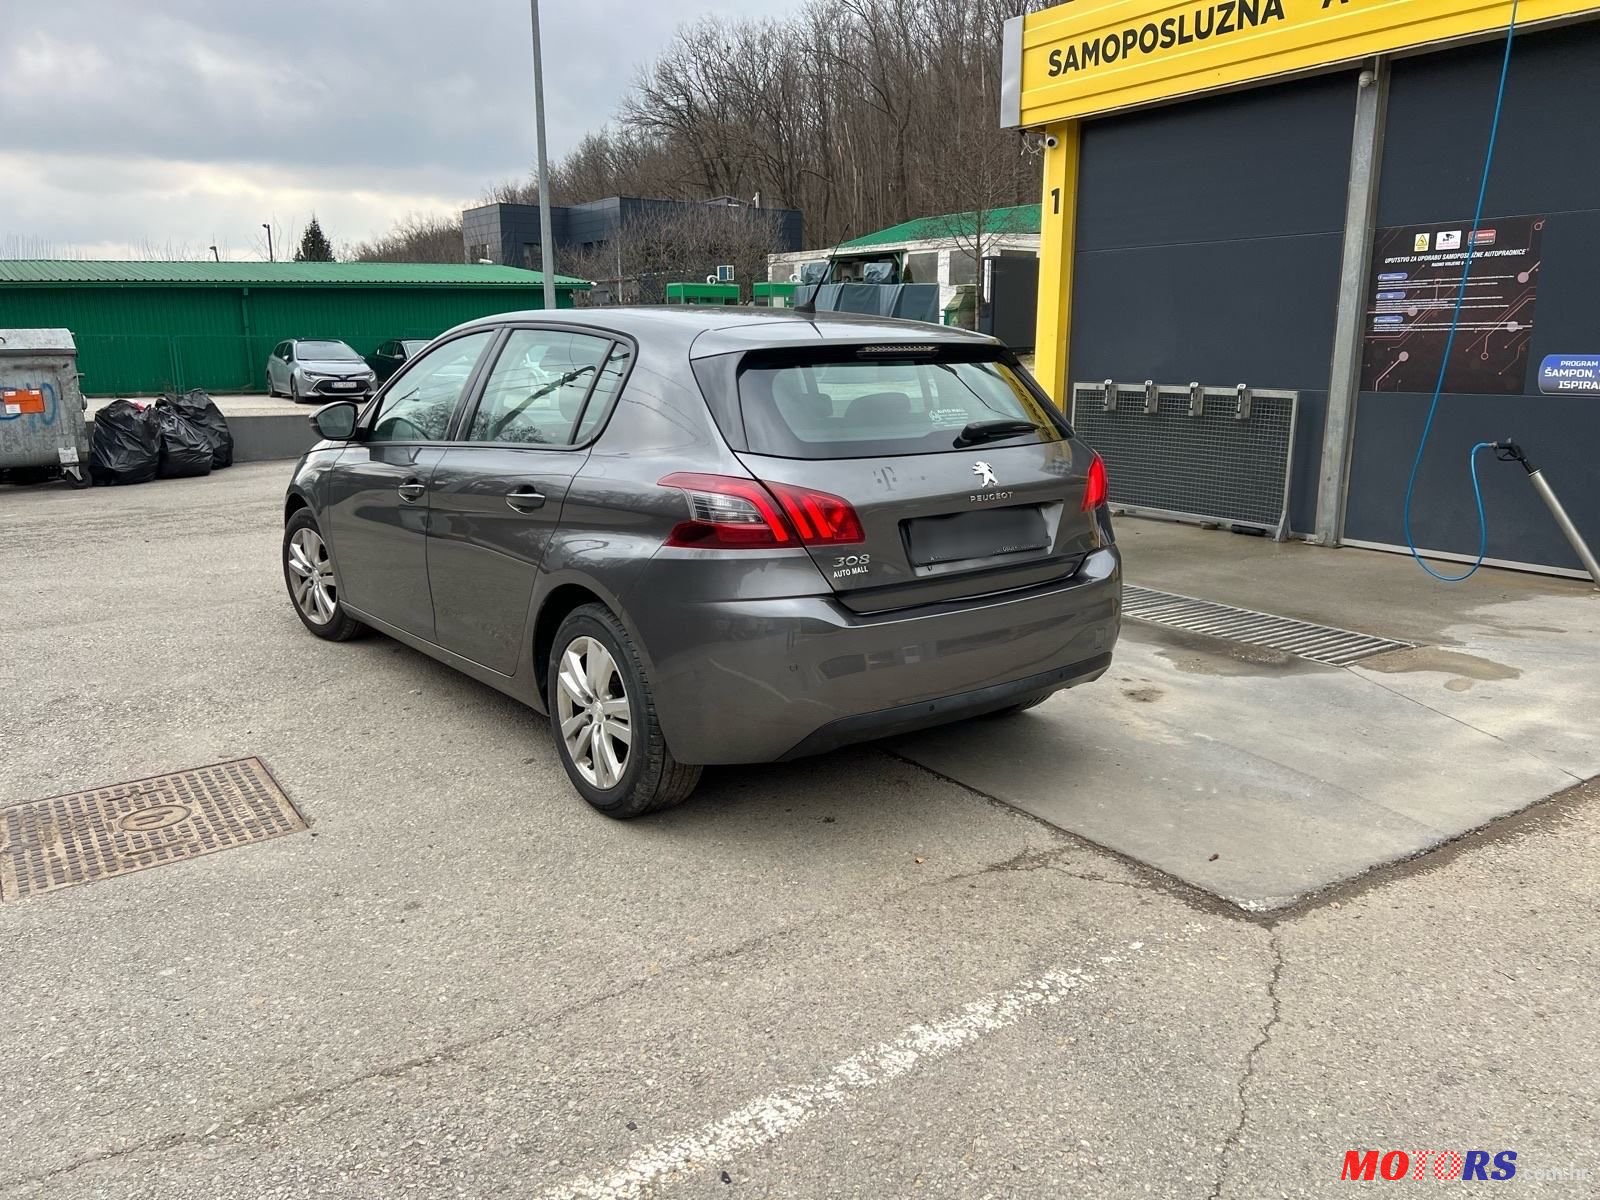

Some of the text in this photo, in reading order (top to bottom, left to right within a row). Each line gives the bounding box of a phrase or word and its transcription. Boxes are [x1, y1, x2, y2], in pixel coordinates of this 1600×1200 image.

[1051, 187, 1060, 215] 1
[1544, 366, 1595, 379] ŠAMPON,
[1558, 380, 1600, 390] ISPIRA
[970, 491, 1014, 502] PEUGEOT
[832, 554, 870, 568] 308
[833, 565, 869, 578] AUTO MALL
